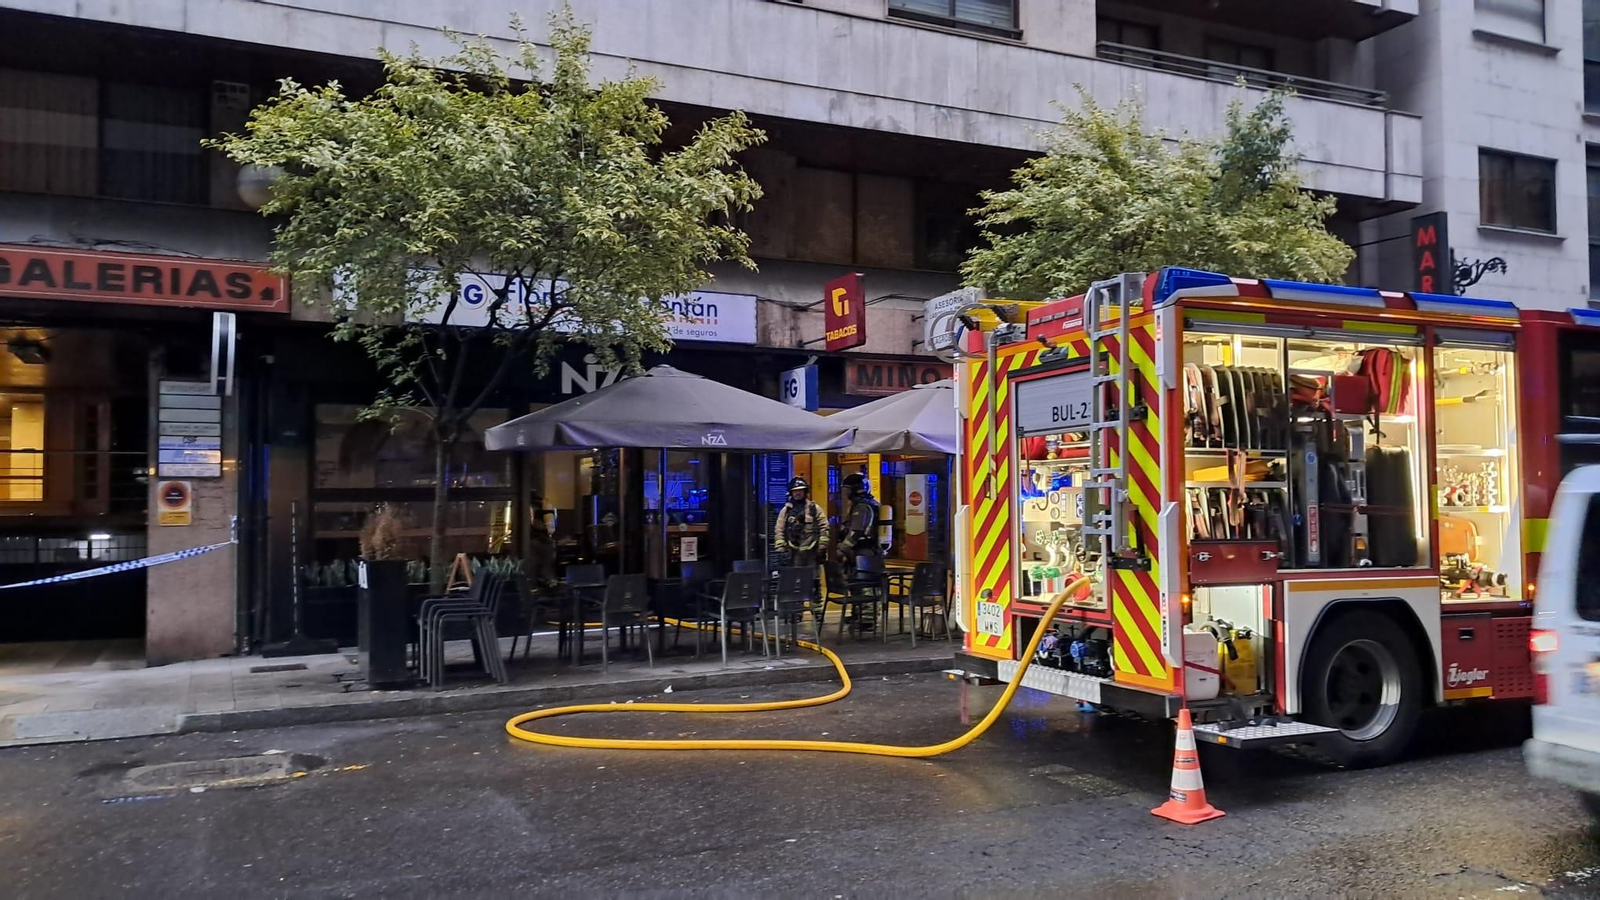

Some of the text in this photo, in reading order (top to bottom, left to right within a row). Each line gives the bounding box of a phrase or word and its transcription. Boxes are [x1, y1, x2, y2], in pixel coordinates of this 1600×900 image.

[1415, 225, 1437, 293] MAR
[673, 326, 718, 338] de seguros
[826, 324, 857, 342] TABACOS
[784, 378, 798, 399] FG
[1052, 402, 1091, 422] BUL-2
[982, 604, 1000, 618] 3402
